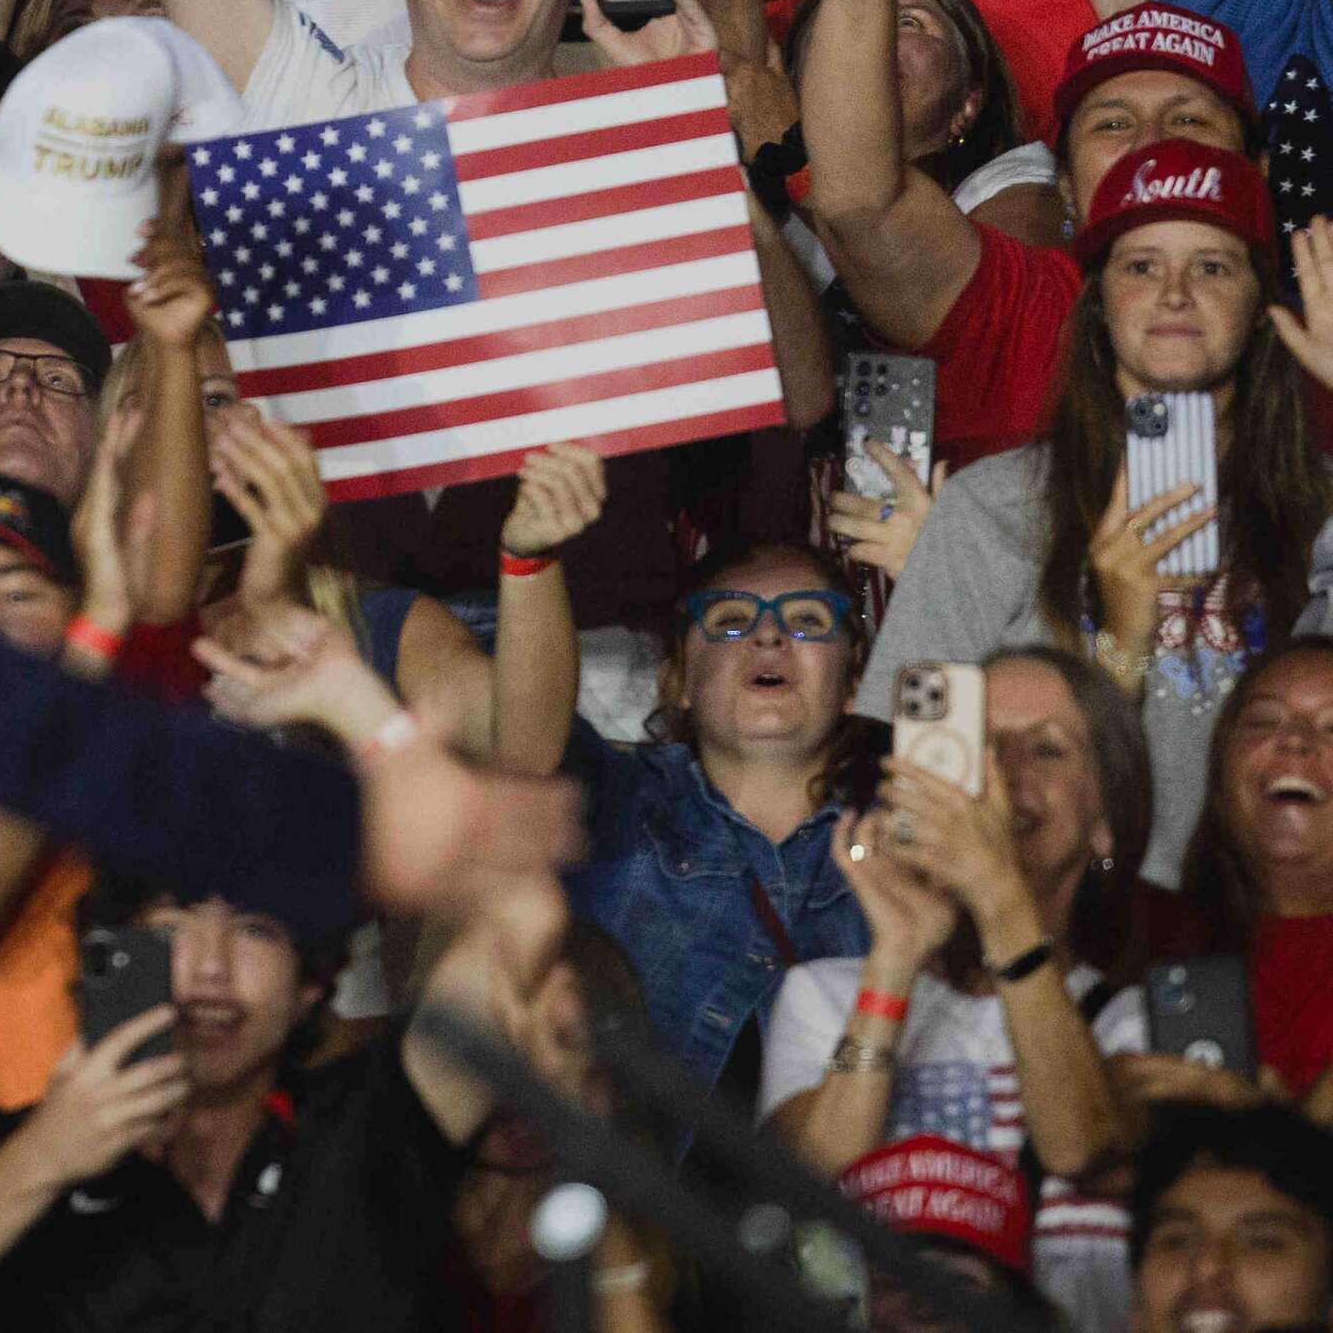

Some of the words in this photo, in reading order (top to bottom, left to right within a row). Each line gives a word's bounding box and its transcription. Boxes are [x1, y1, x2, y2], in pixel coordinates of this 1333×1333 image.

[1082, 14, 1134, 51] MAKE
[1137, 9, 1226, 49] AMERICA
[1151, 31, 1215, 67] AGAIN
[34, 144, 146, 181] TRUMP
[1120, 158, 1222, 207] South
